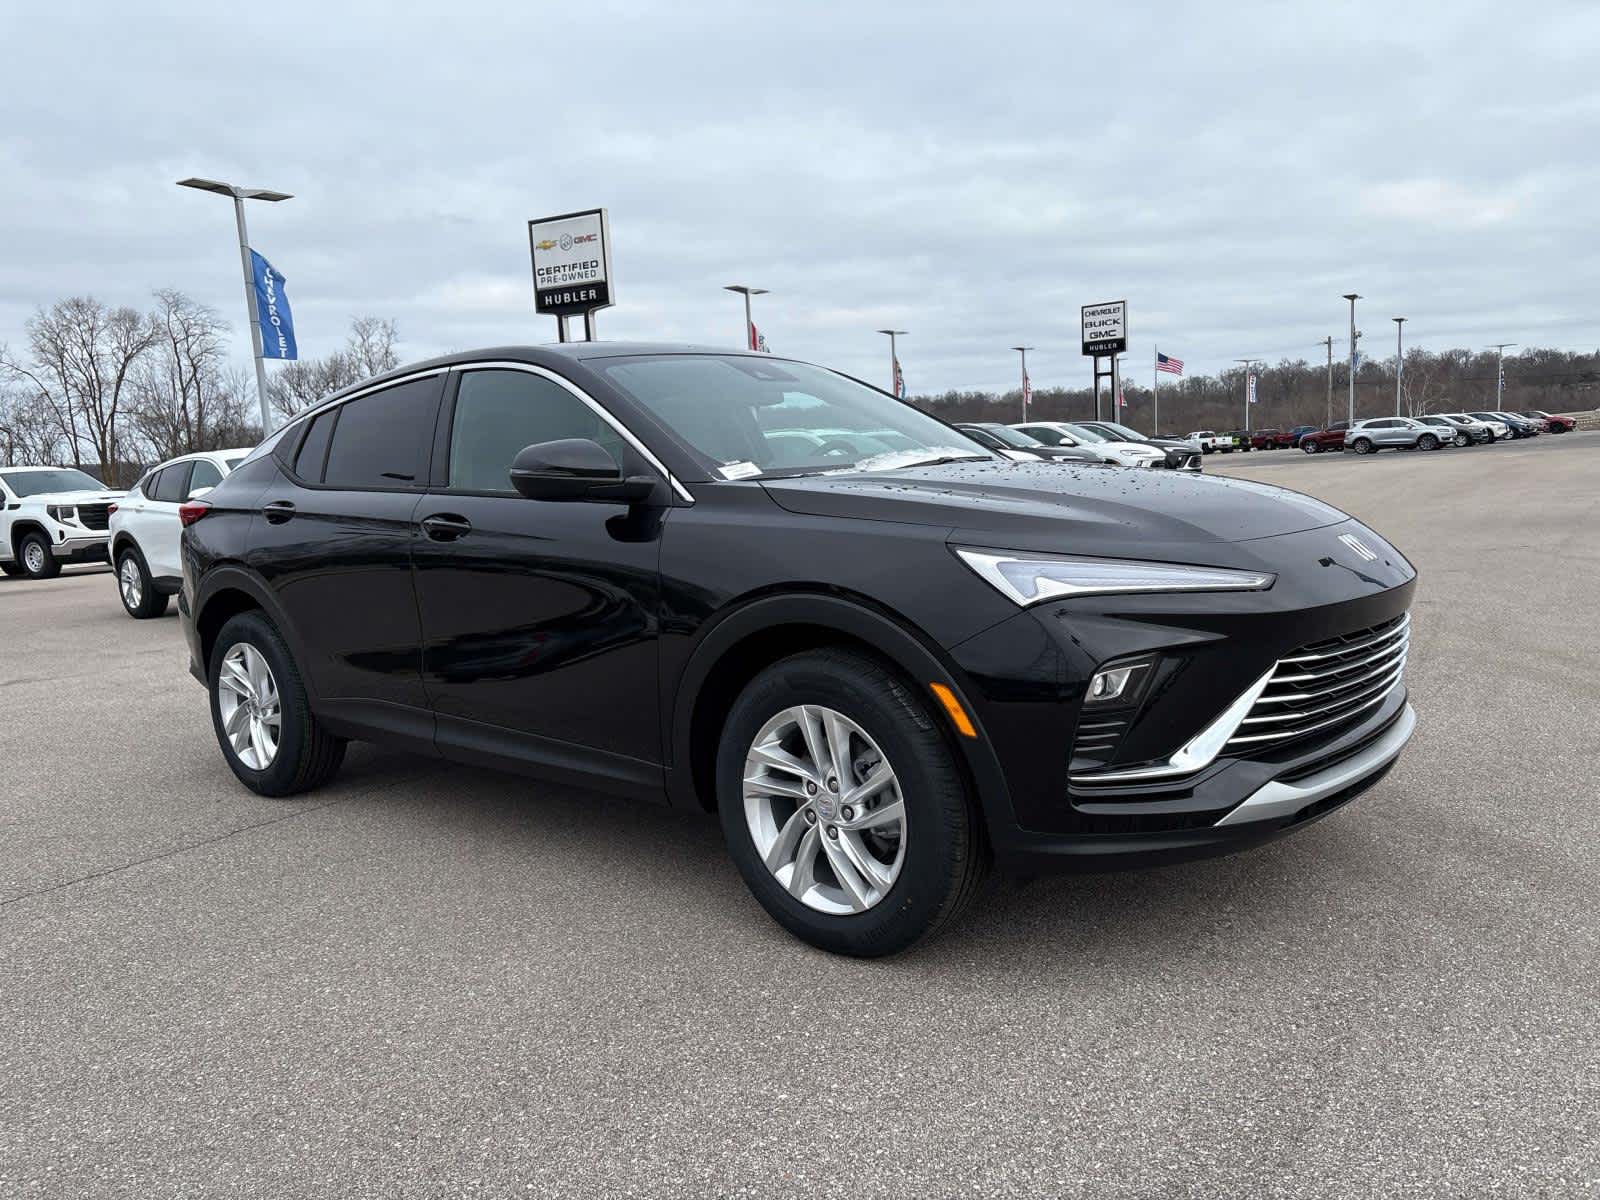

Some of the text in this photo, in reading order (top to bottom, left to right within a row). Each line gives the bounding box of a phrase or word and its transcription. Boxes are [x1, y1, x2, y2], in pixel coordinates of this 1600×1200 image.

[573, 233, 598, 244] GMC
[537, 260, 599, 276] CERTIFIED
[540, 270, 597, 284] PRE-OWNED
[545, 289, 597, 305] HUBLER
[1085, 319, 1120, 328] BUICK
[1090, 330, 1117, 339] GMC
[1090, 343, 1117, 351] HUBLER
